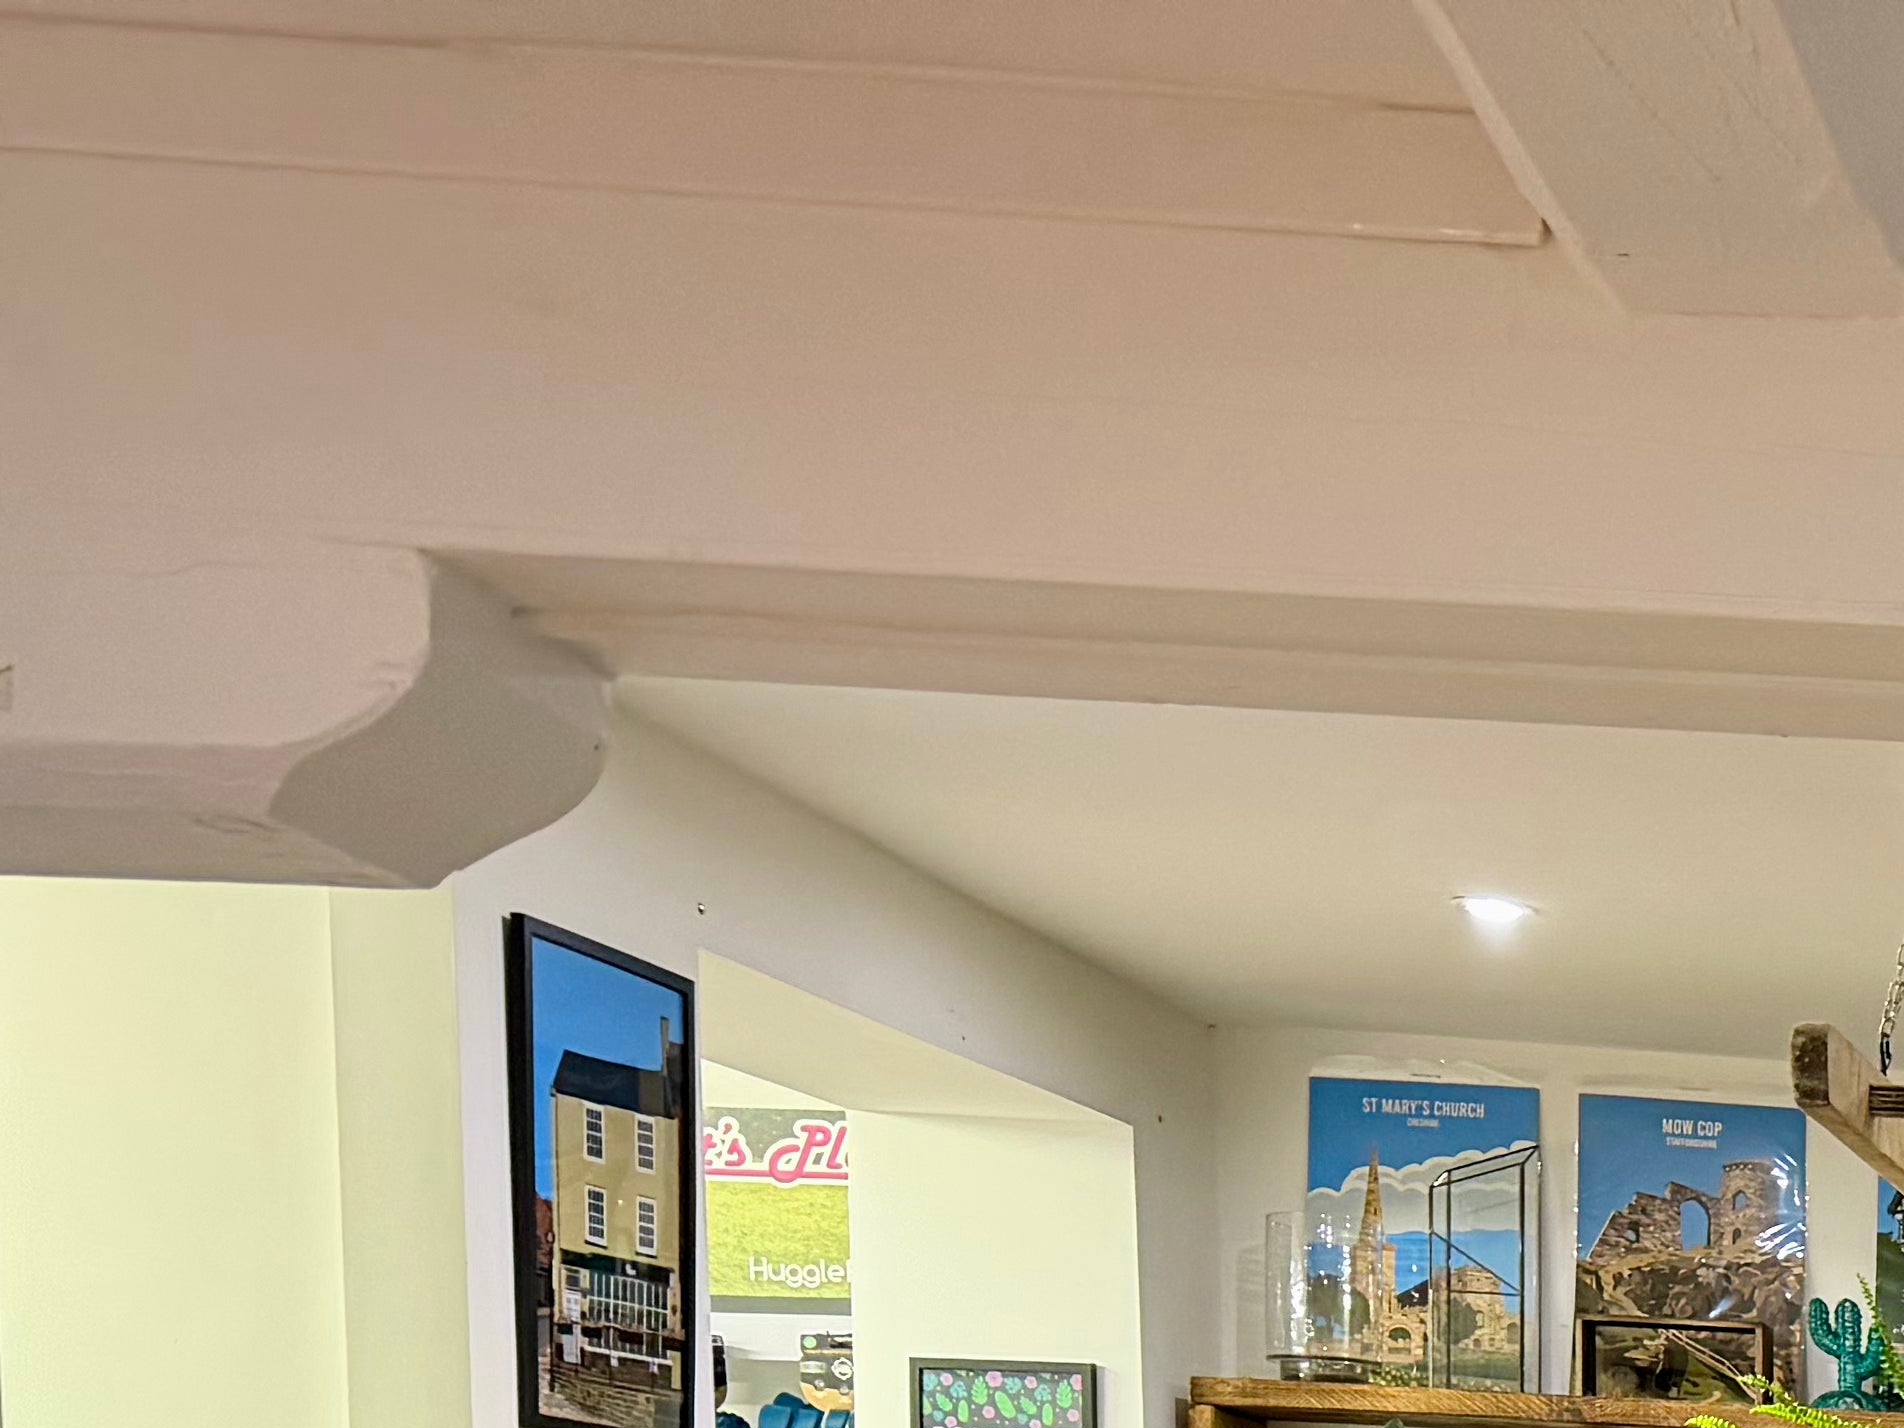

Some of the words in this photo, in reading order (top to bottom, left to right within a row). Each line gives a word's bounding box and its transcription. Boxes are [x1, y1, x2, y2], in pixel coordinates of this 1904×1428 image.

[1362, 1098, 1379, 1113] ST
[1382, 1099, 1431, 1117] MARY'S
[1434, 1102, 1485, 1119] CHURCH
[1662, 1118, 1694, 1136] MOW
[1697, 1120, 1723, 1138] COP
